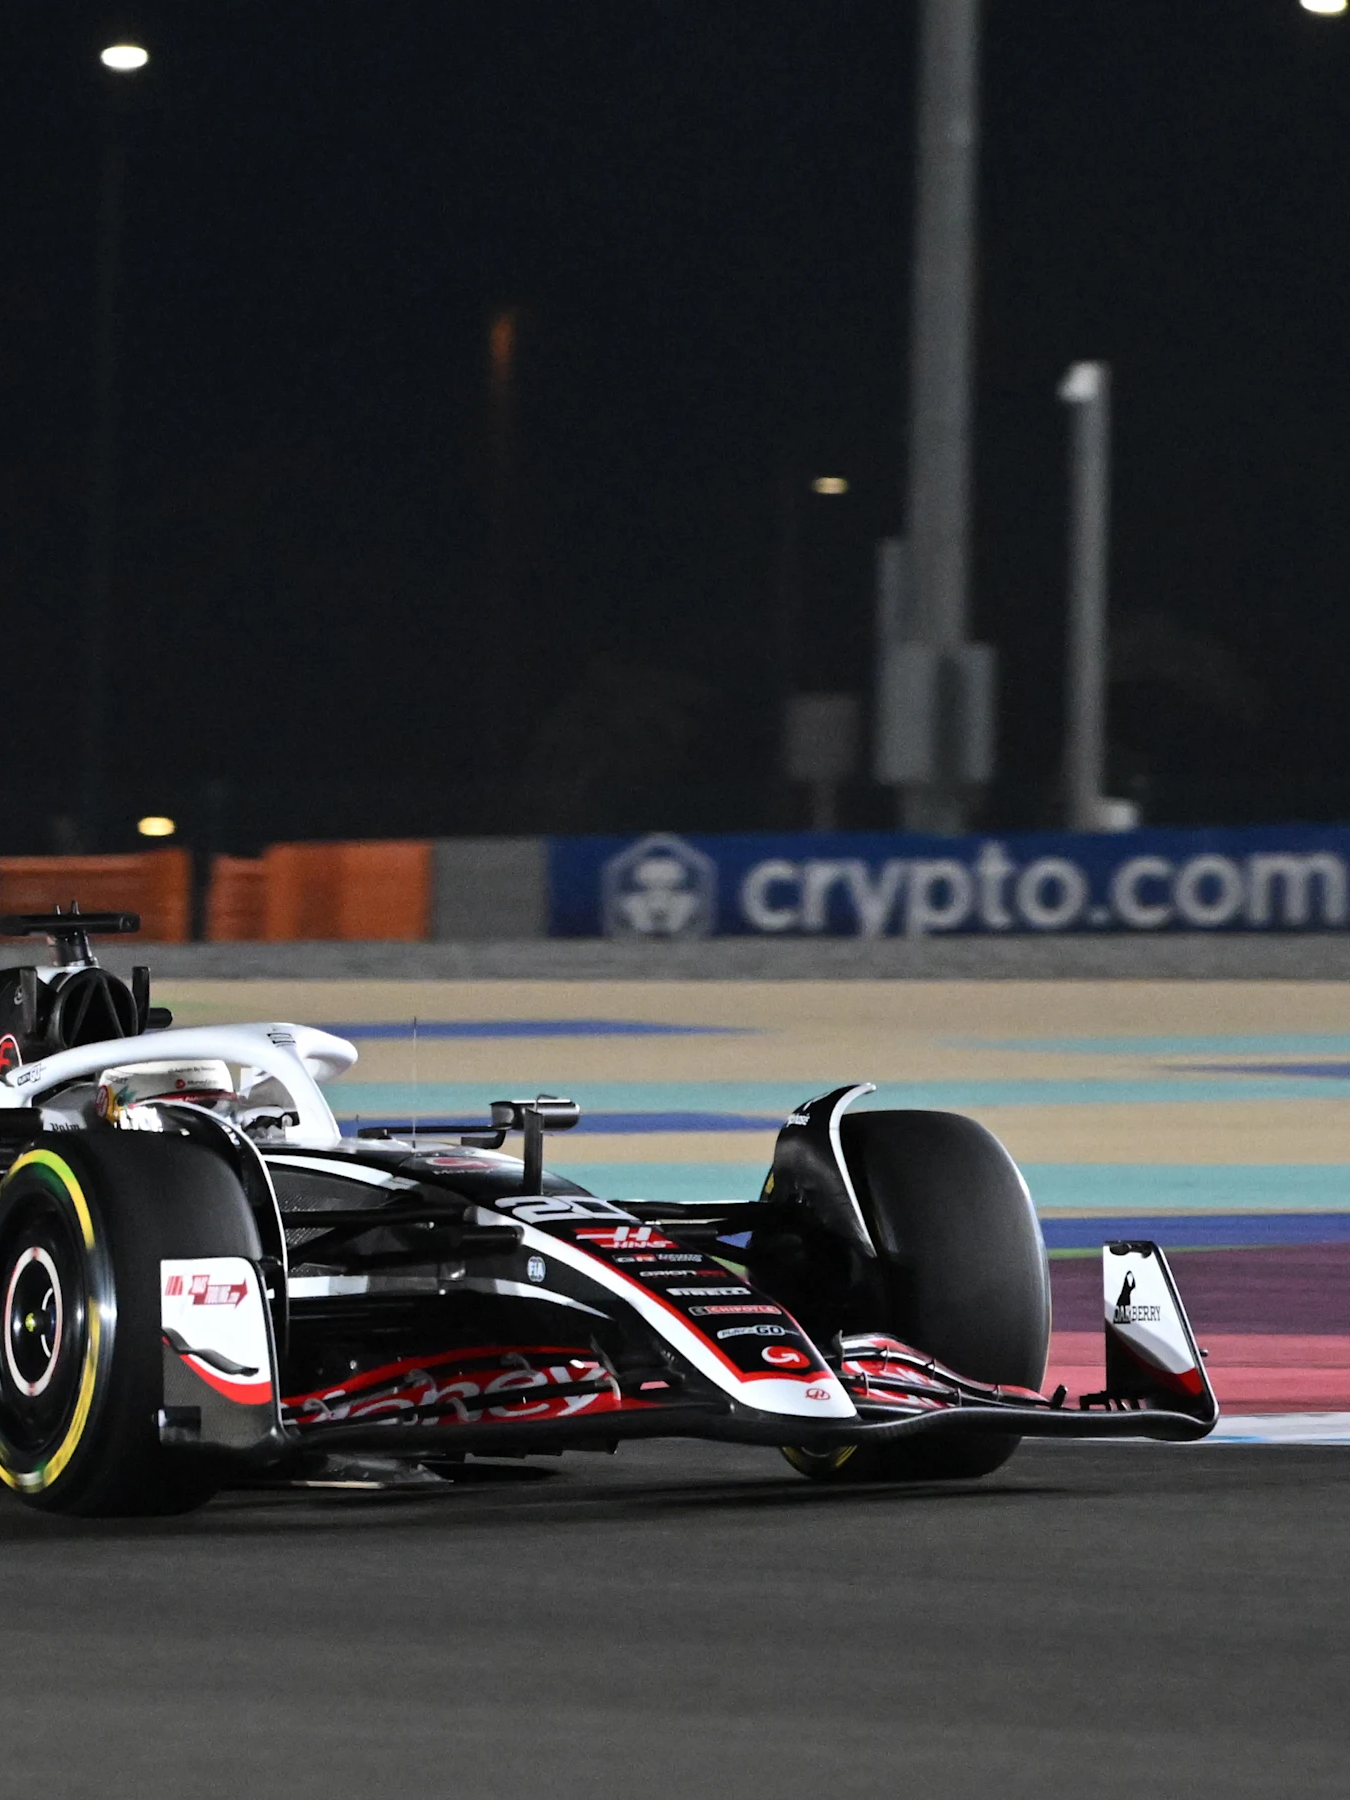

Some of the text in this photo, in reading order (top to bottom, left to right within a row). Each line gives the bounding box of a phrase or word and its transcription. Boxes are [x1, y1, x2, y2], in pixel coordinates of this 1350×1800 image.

[742, 842, 1347, 936] crypto.com
[495, 1196, 641, 1224] 20
[1113, 1305, 1161, 1324] OAKBERRY
